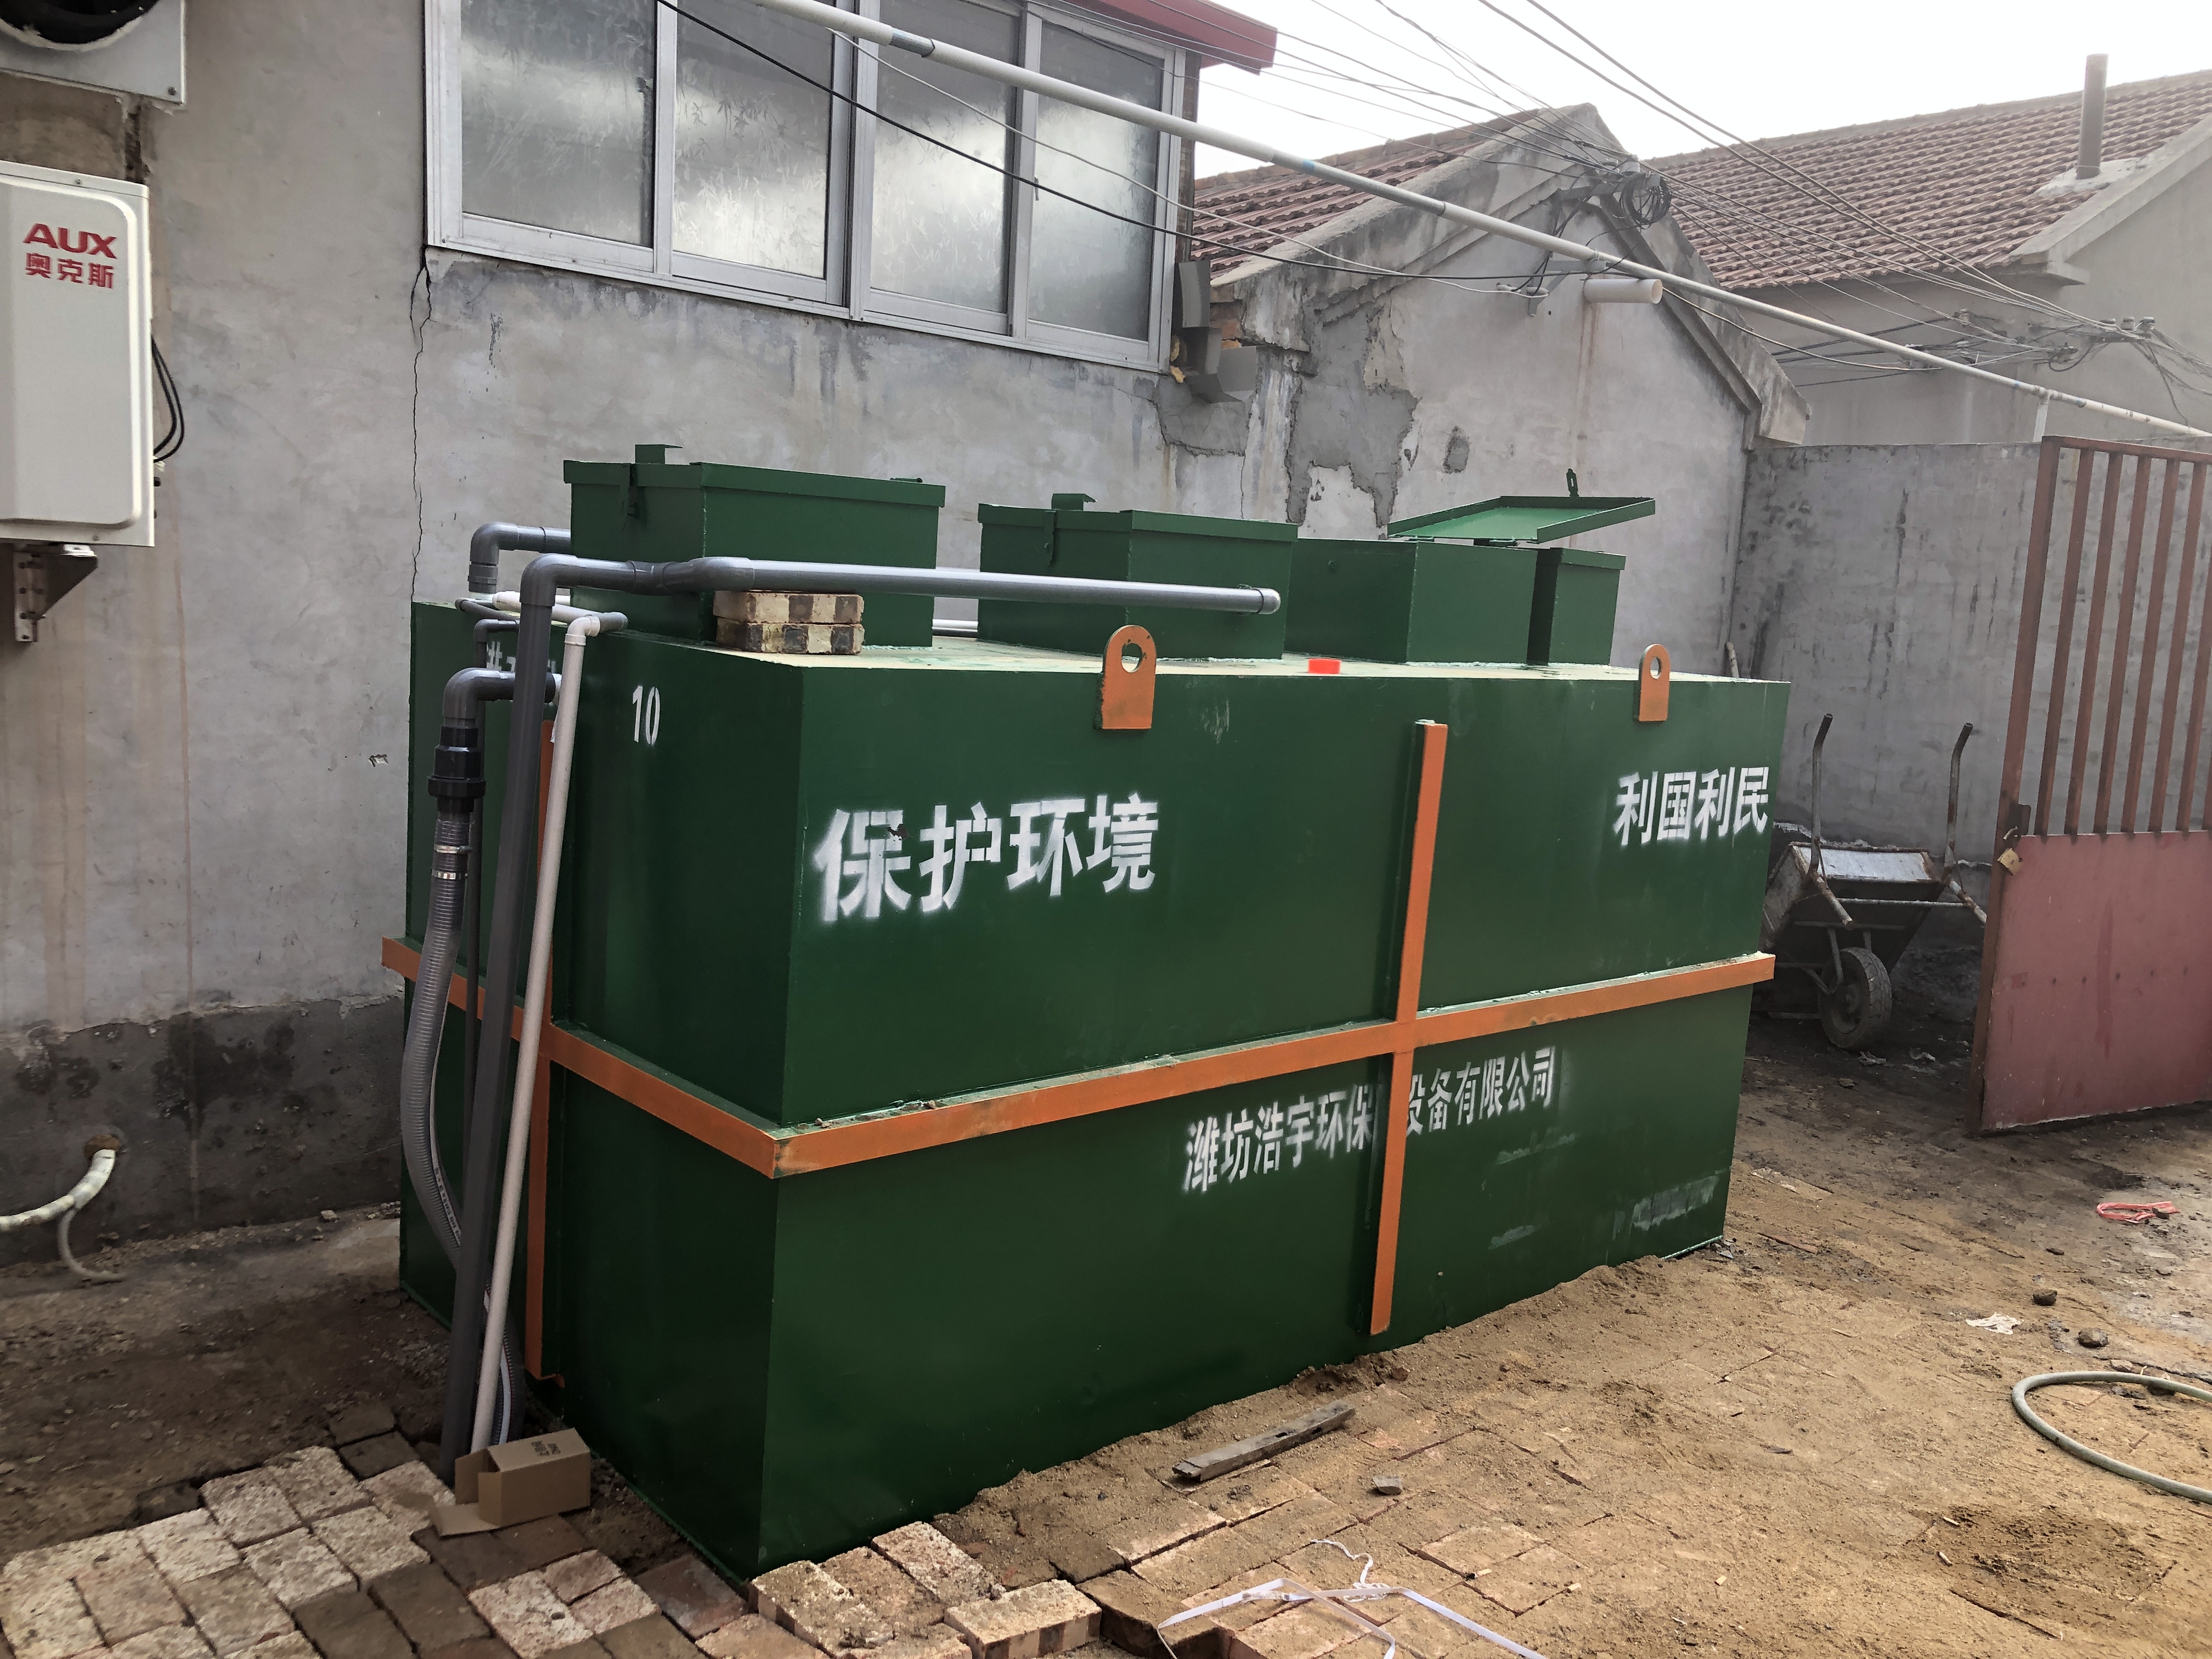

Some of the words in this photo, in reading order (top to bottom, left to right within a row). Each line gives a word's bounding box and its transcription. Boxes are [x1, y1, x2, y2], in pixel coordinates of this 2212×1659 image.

[22, 223, 117, 259] AUX
[25, 252, 114, 289] 奥克斯
[633, 686, 661, 745] 10
[1613, 766, 1769, 846] 利国利民
[815, 793, 1159, 922] 保护环境
